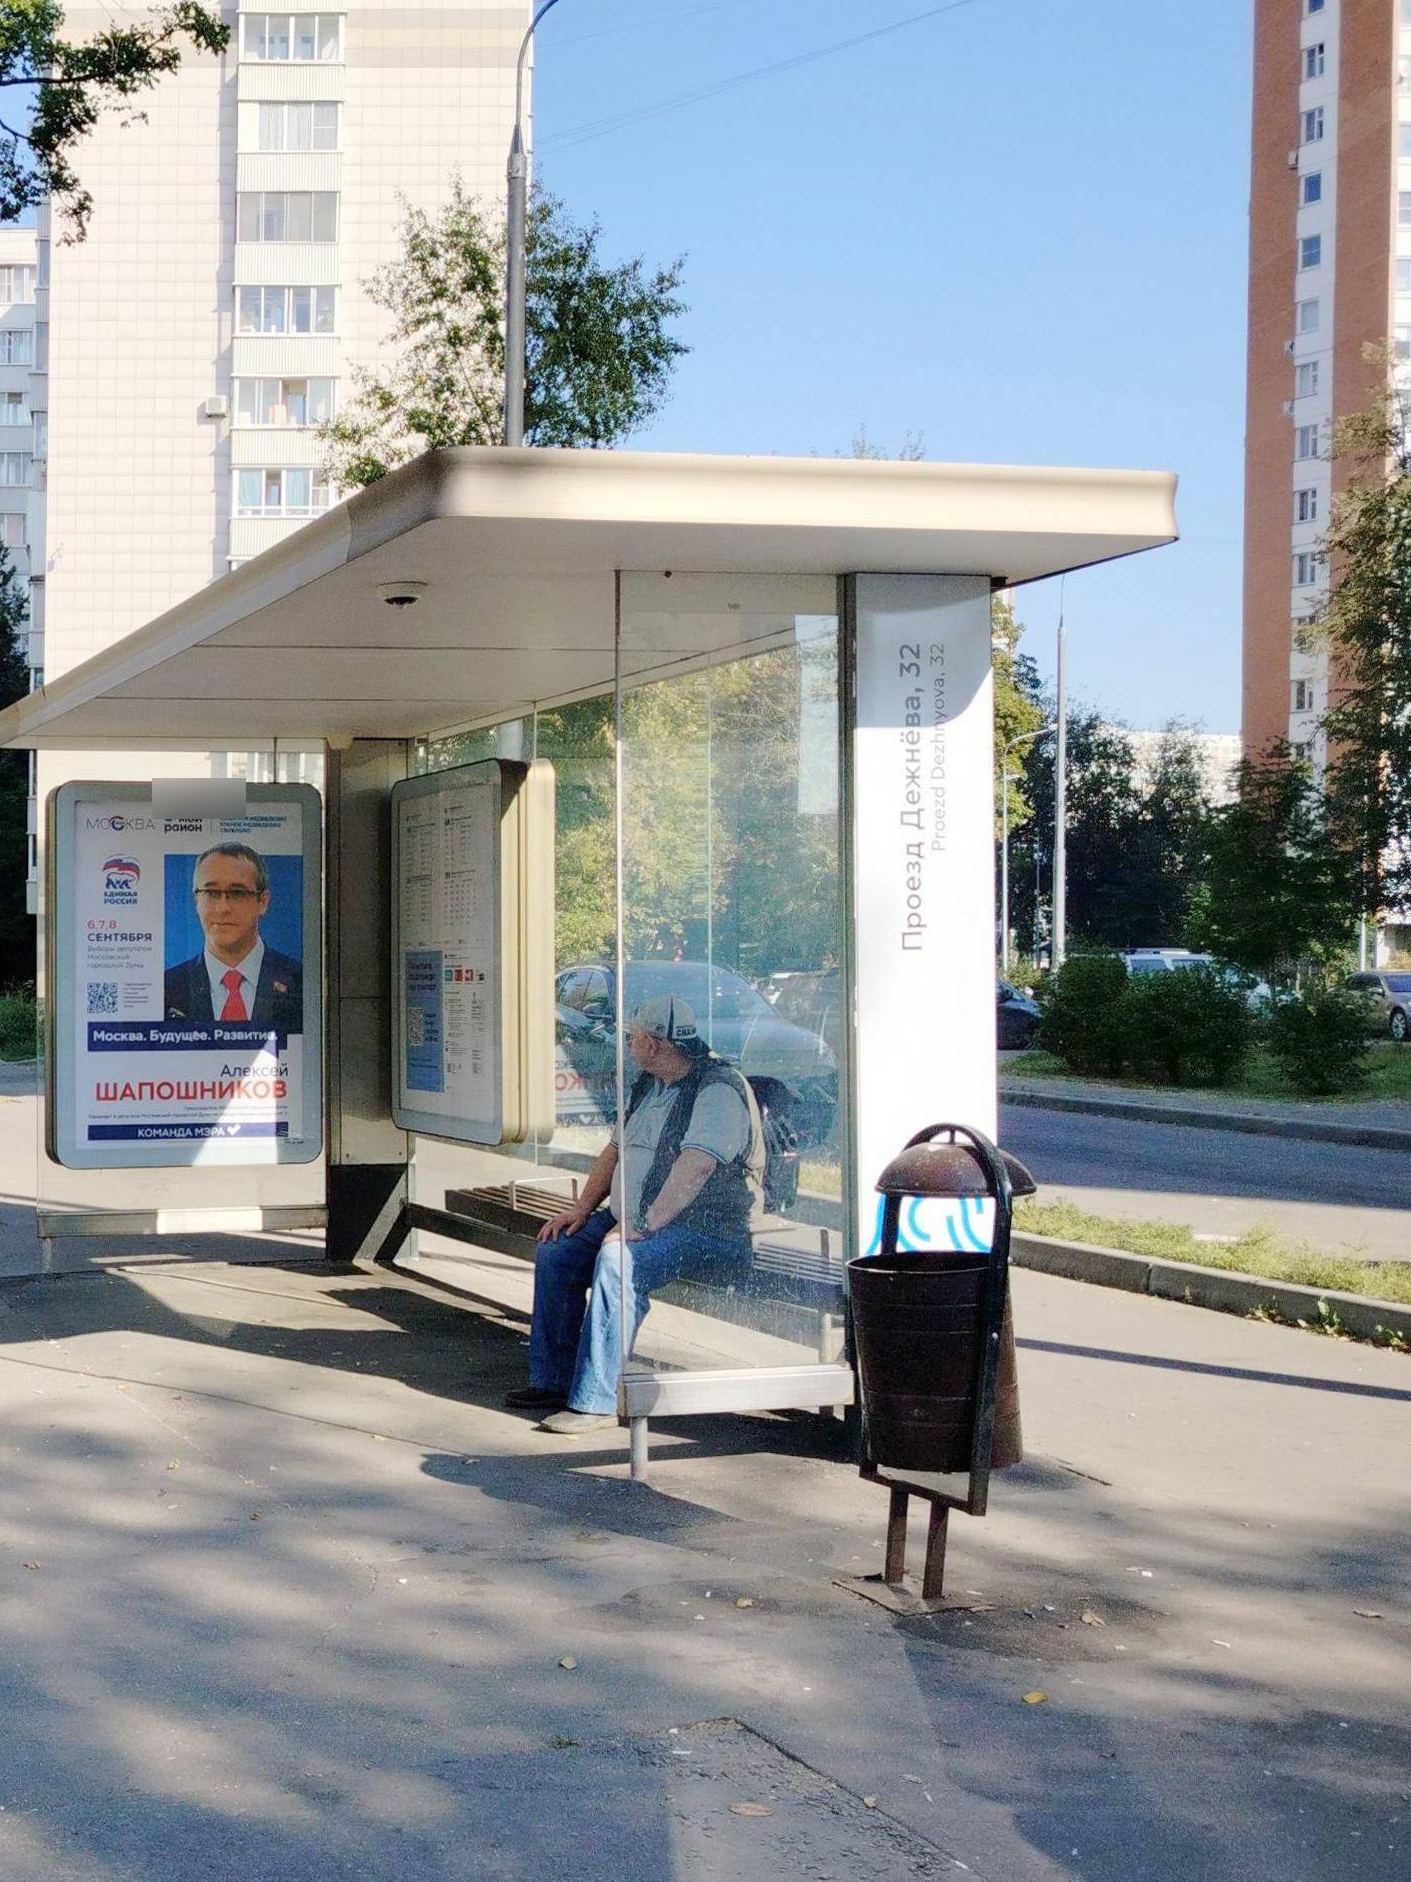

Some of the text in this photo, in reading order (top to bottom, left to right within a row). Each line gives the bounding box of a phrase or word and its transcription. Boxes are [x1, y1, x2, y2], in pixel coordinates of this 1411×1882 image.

[929, 643, 948, 852] Proezd Dezhnyova, 32
[899, 643, 927, 951] Проезд Дежнёва, 32
[86, 816, 156, 831] МОСКВА
[87, 932, 153, 942] СЕНТЯБРЯ
[93, 1030, 147, 1042] Москва.
[149, 1029, 211, 1045] Будущее.
[220, 1063, 288, 1078] Алексей
[95, 1079, 287, 1101] ШАПОШНИКОВ
[137, 1126, 225, 1138] КОМАНДА МЭРА
